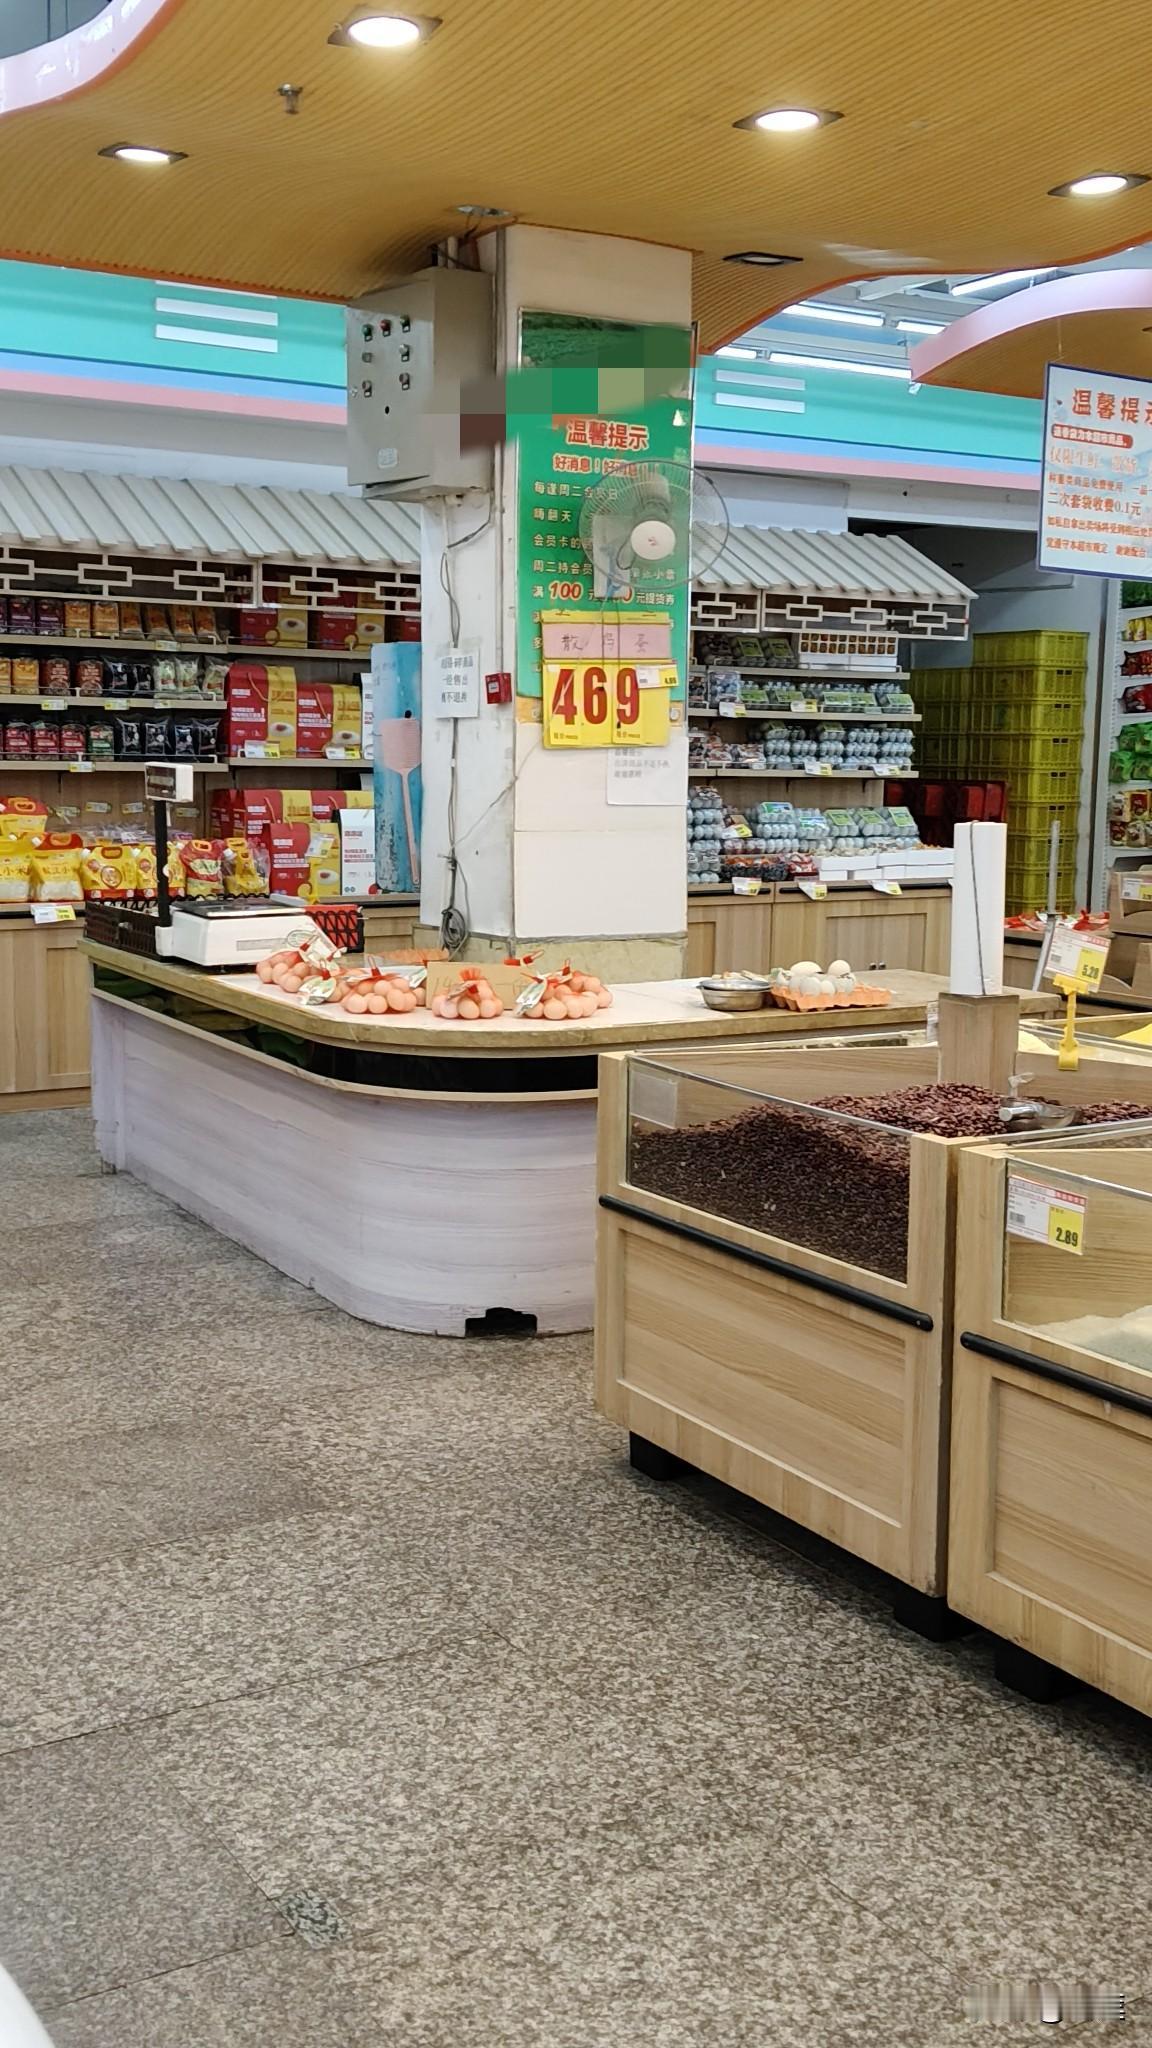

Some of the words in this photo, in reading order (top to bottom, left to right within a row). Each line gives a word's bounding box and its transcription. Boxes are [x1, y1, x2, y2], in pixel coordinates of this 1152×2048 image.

[567, 420, 648, 449] 温馨提示
[1055, 1226, 1079, 1247] 2.89
